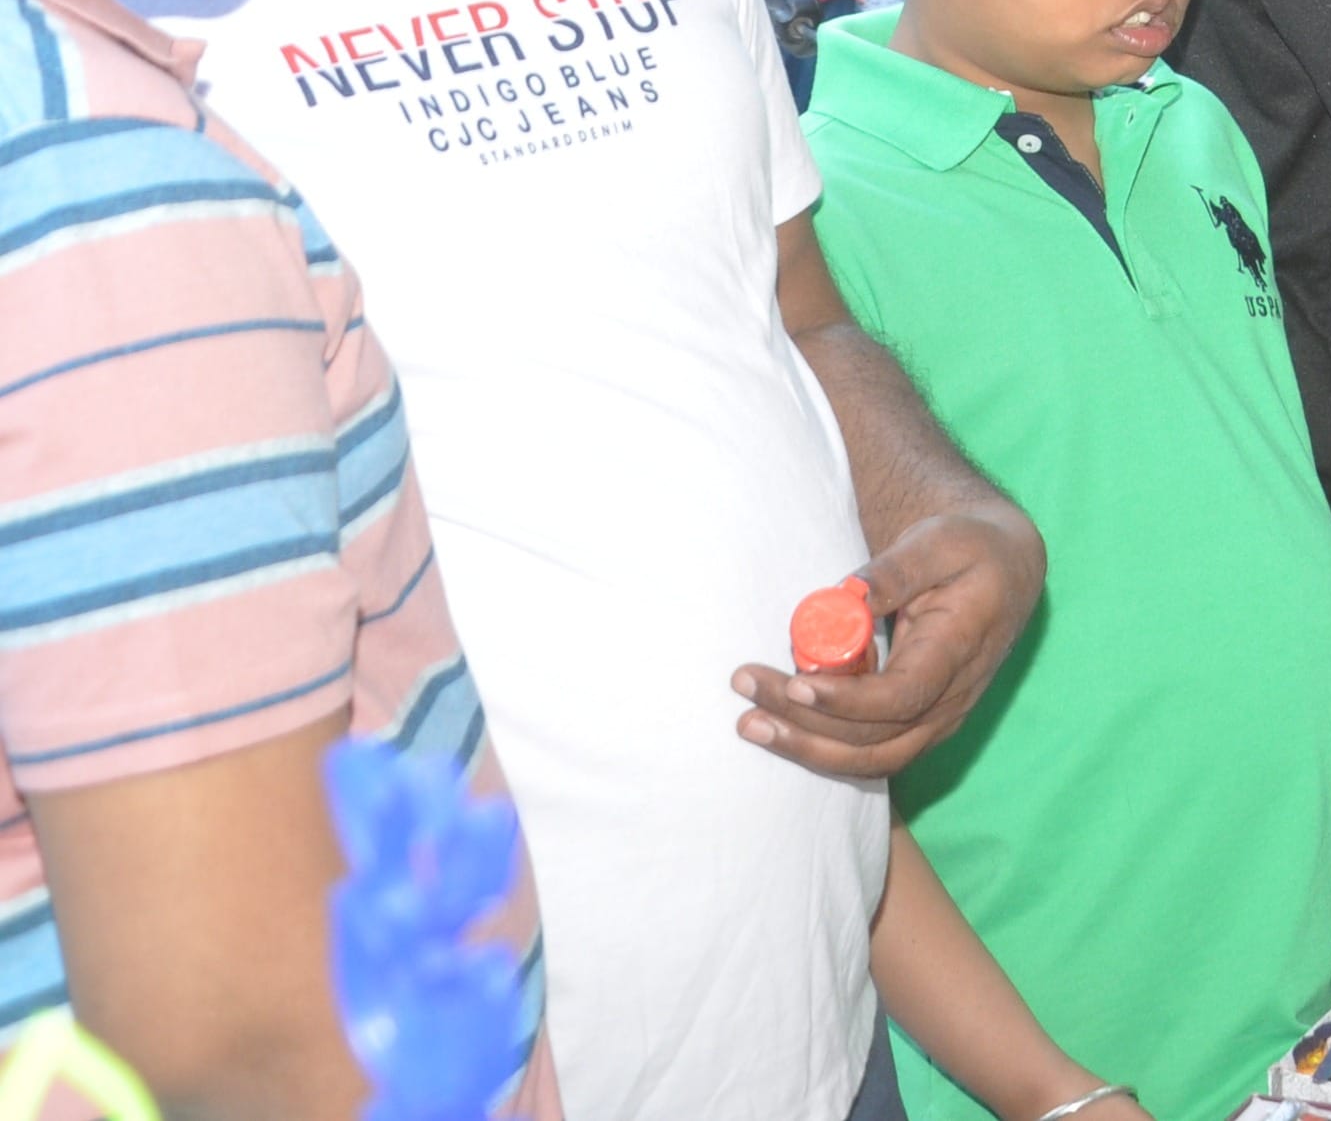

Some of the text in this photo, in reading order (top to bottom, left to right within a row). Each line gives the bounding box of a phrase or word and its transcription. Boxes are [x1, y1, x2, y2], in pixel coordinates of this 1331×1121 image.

[279, 1, 527, 108] NEVER
[399, 46, 659, 124] INDIGO BLUE
[428, 80, 661, 153] CJC JEANS
[479, 119, 634, 166] STANDARD DENIM
